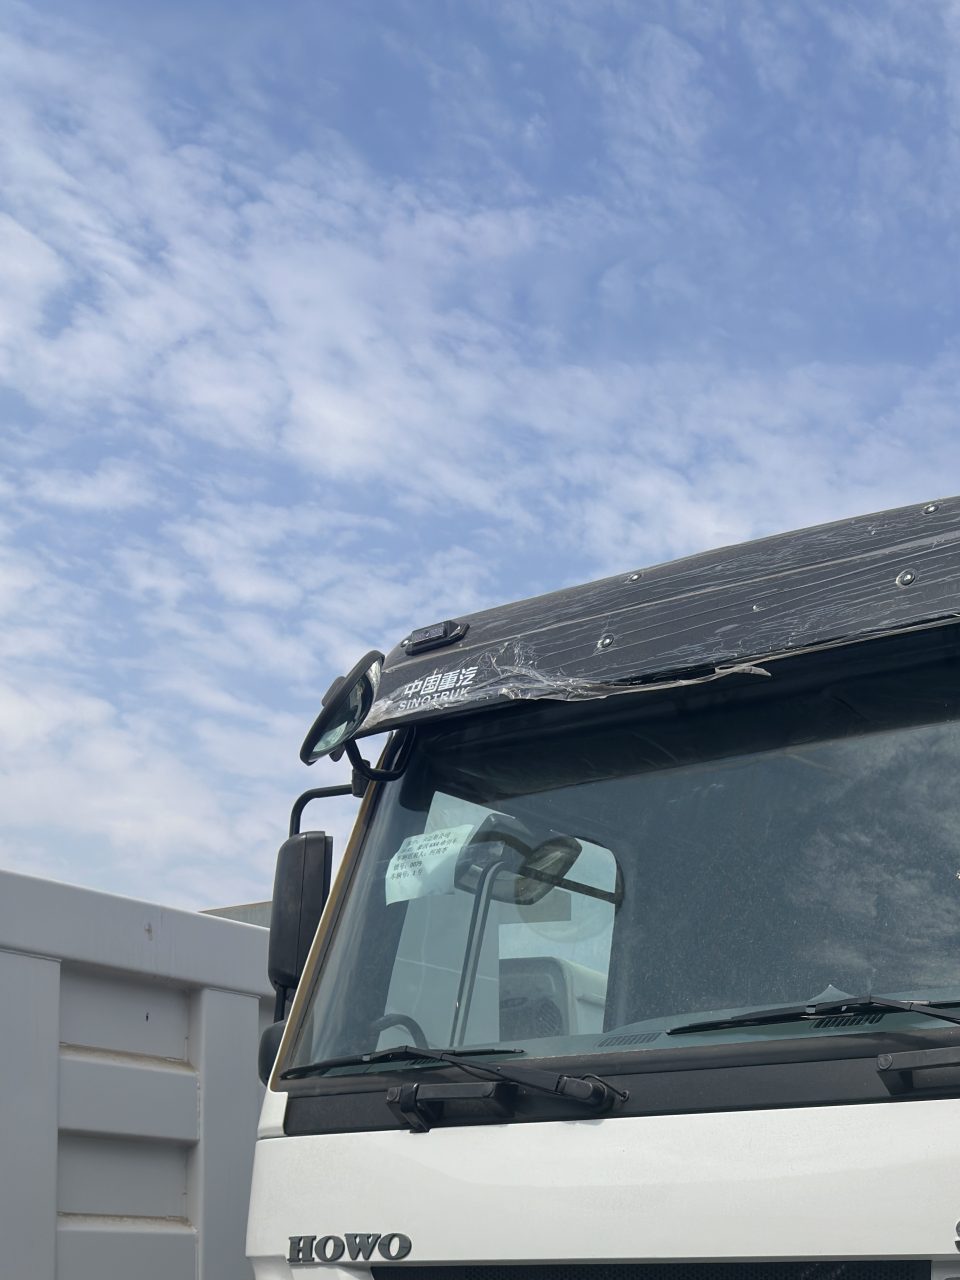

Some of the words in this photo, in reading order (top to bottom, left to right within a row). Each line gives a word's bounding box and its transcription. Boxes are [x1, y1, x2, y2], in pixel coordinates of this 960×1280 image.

[404, 666, 478, 697] 中国重汽
[287, 1232, 412, 1263] HOWO
